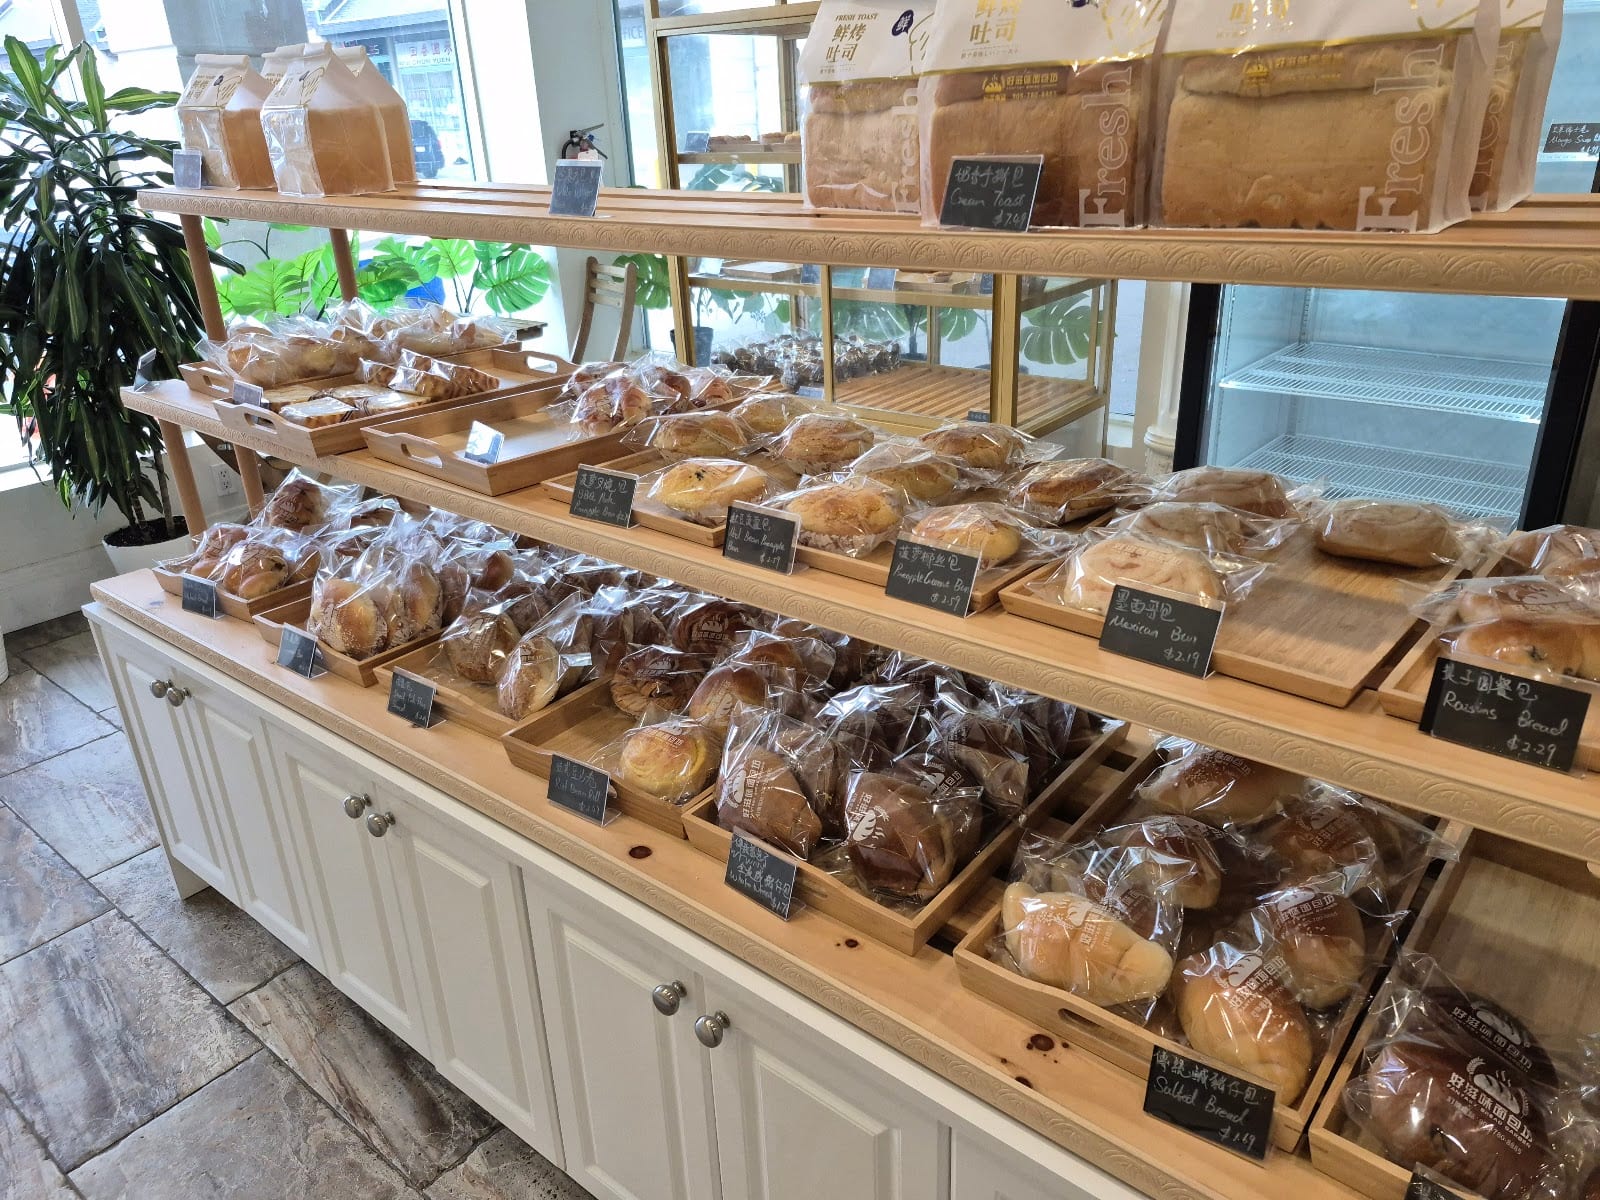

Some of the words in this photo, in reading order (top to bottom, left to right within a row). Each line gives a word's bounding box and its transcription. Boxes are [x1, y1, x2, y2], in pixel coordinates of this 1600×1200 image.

[969, 19, 1017, 45] 吐司
[826, 43, 858, 63] 吐司
[1079, 66, 1133, 228] Fresh
[1355, 43, 1445, 234] Fresh
[993, 190, 1026, 206] Toast
[1108, 615, 1159, 638] Mexican
[1170, 626, 1198, 643] Bun
[1164, 647, 1200, 669] $2.19
[1442, 690, 1498, 720] Raisins
[1518, 710, 1569, 736] Bread
[1507, 734, 1557, 767] $2.29
[1154, 1075, 1198, 1106] Salted
[1204, 1094, 1250, 1126] Bread
[1219, 1125, 1256, 1152] $1.69
